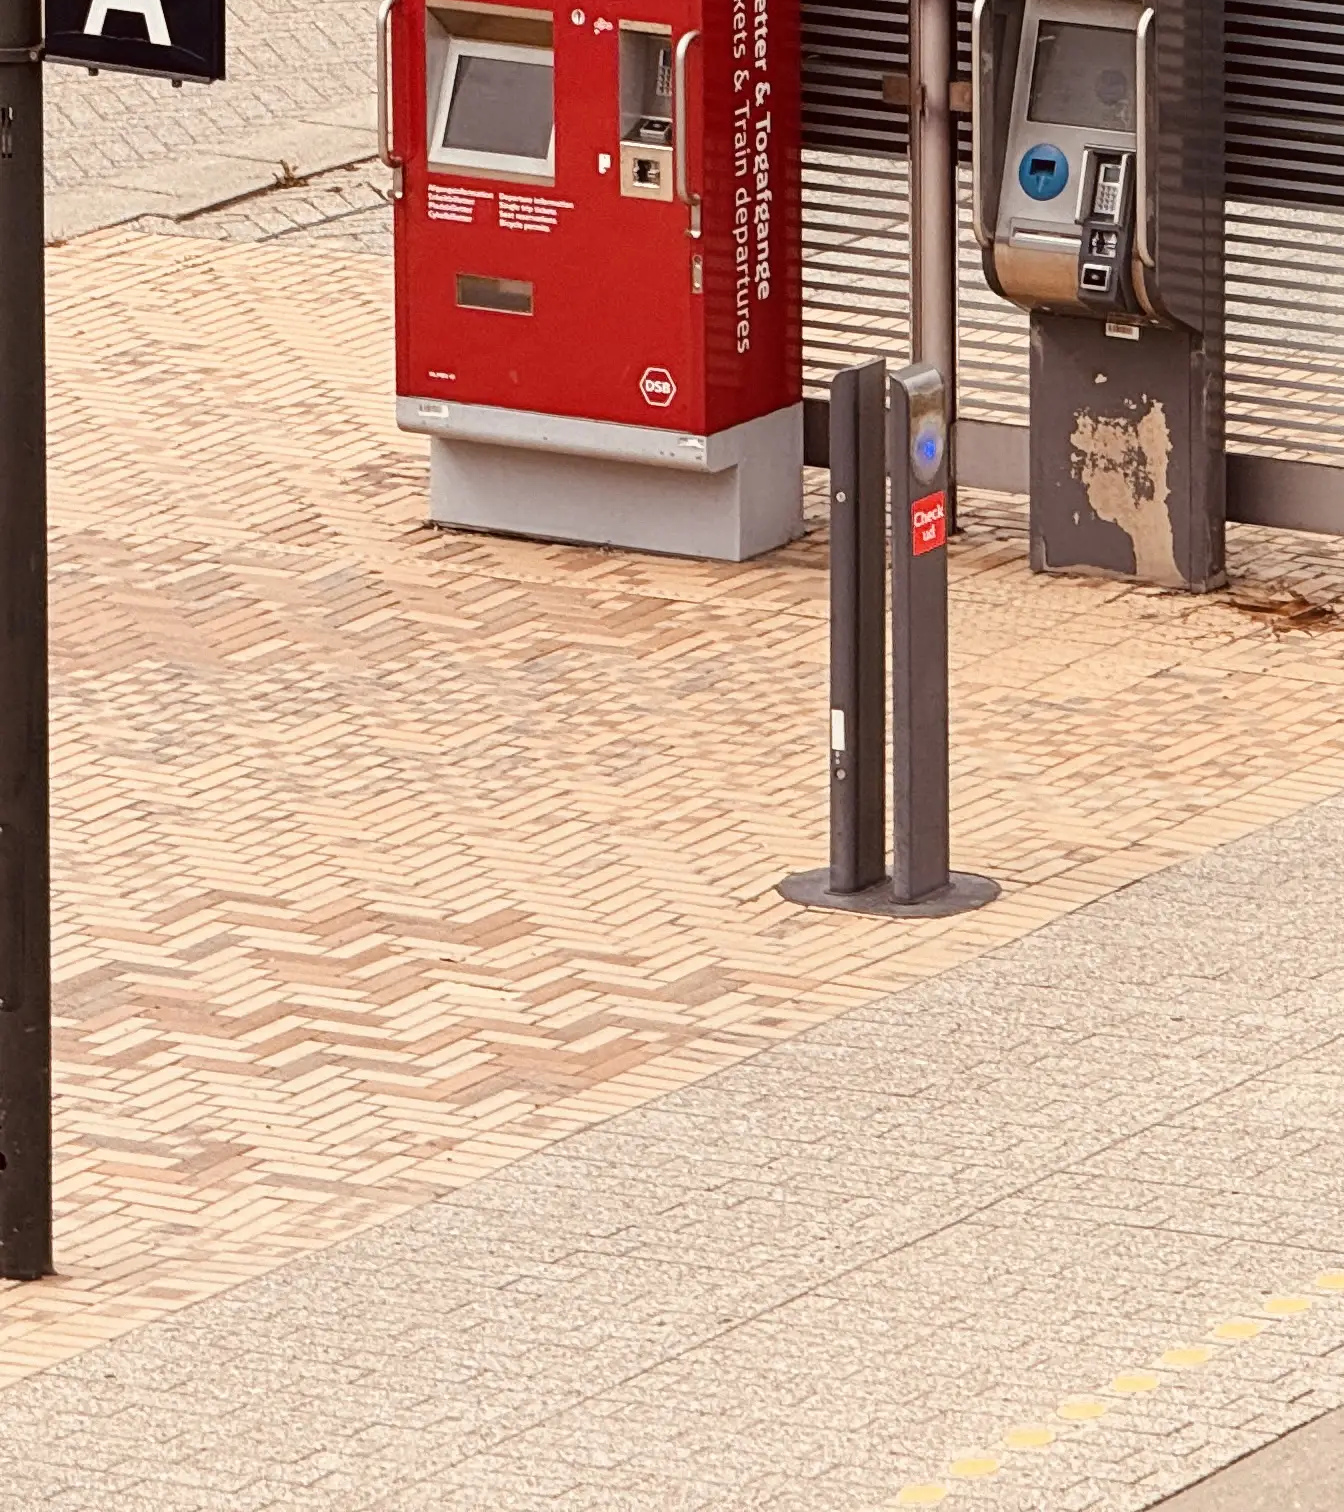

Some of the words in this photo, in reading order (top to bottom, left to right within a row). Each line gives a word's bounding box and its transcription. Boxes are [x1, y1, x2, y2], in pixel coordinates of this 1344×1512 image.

[733, 70, 750, 92] &
[755, 82, 771, 107] &
[734, 99, 751, 176] Train
[753, 111, 772, 300] Togafgange
[732, 187, 751, 353] departures
[645, 380, 670, 395] DSB
[913, 504, 944, 528] Check
